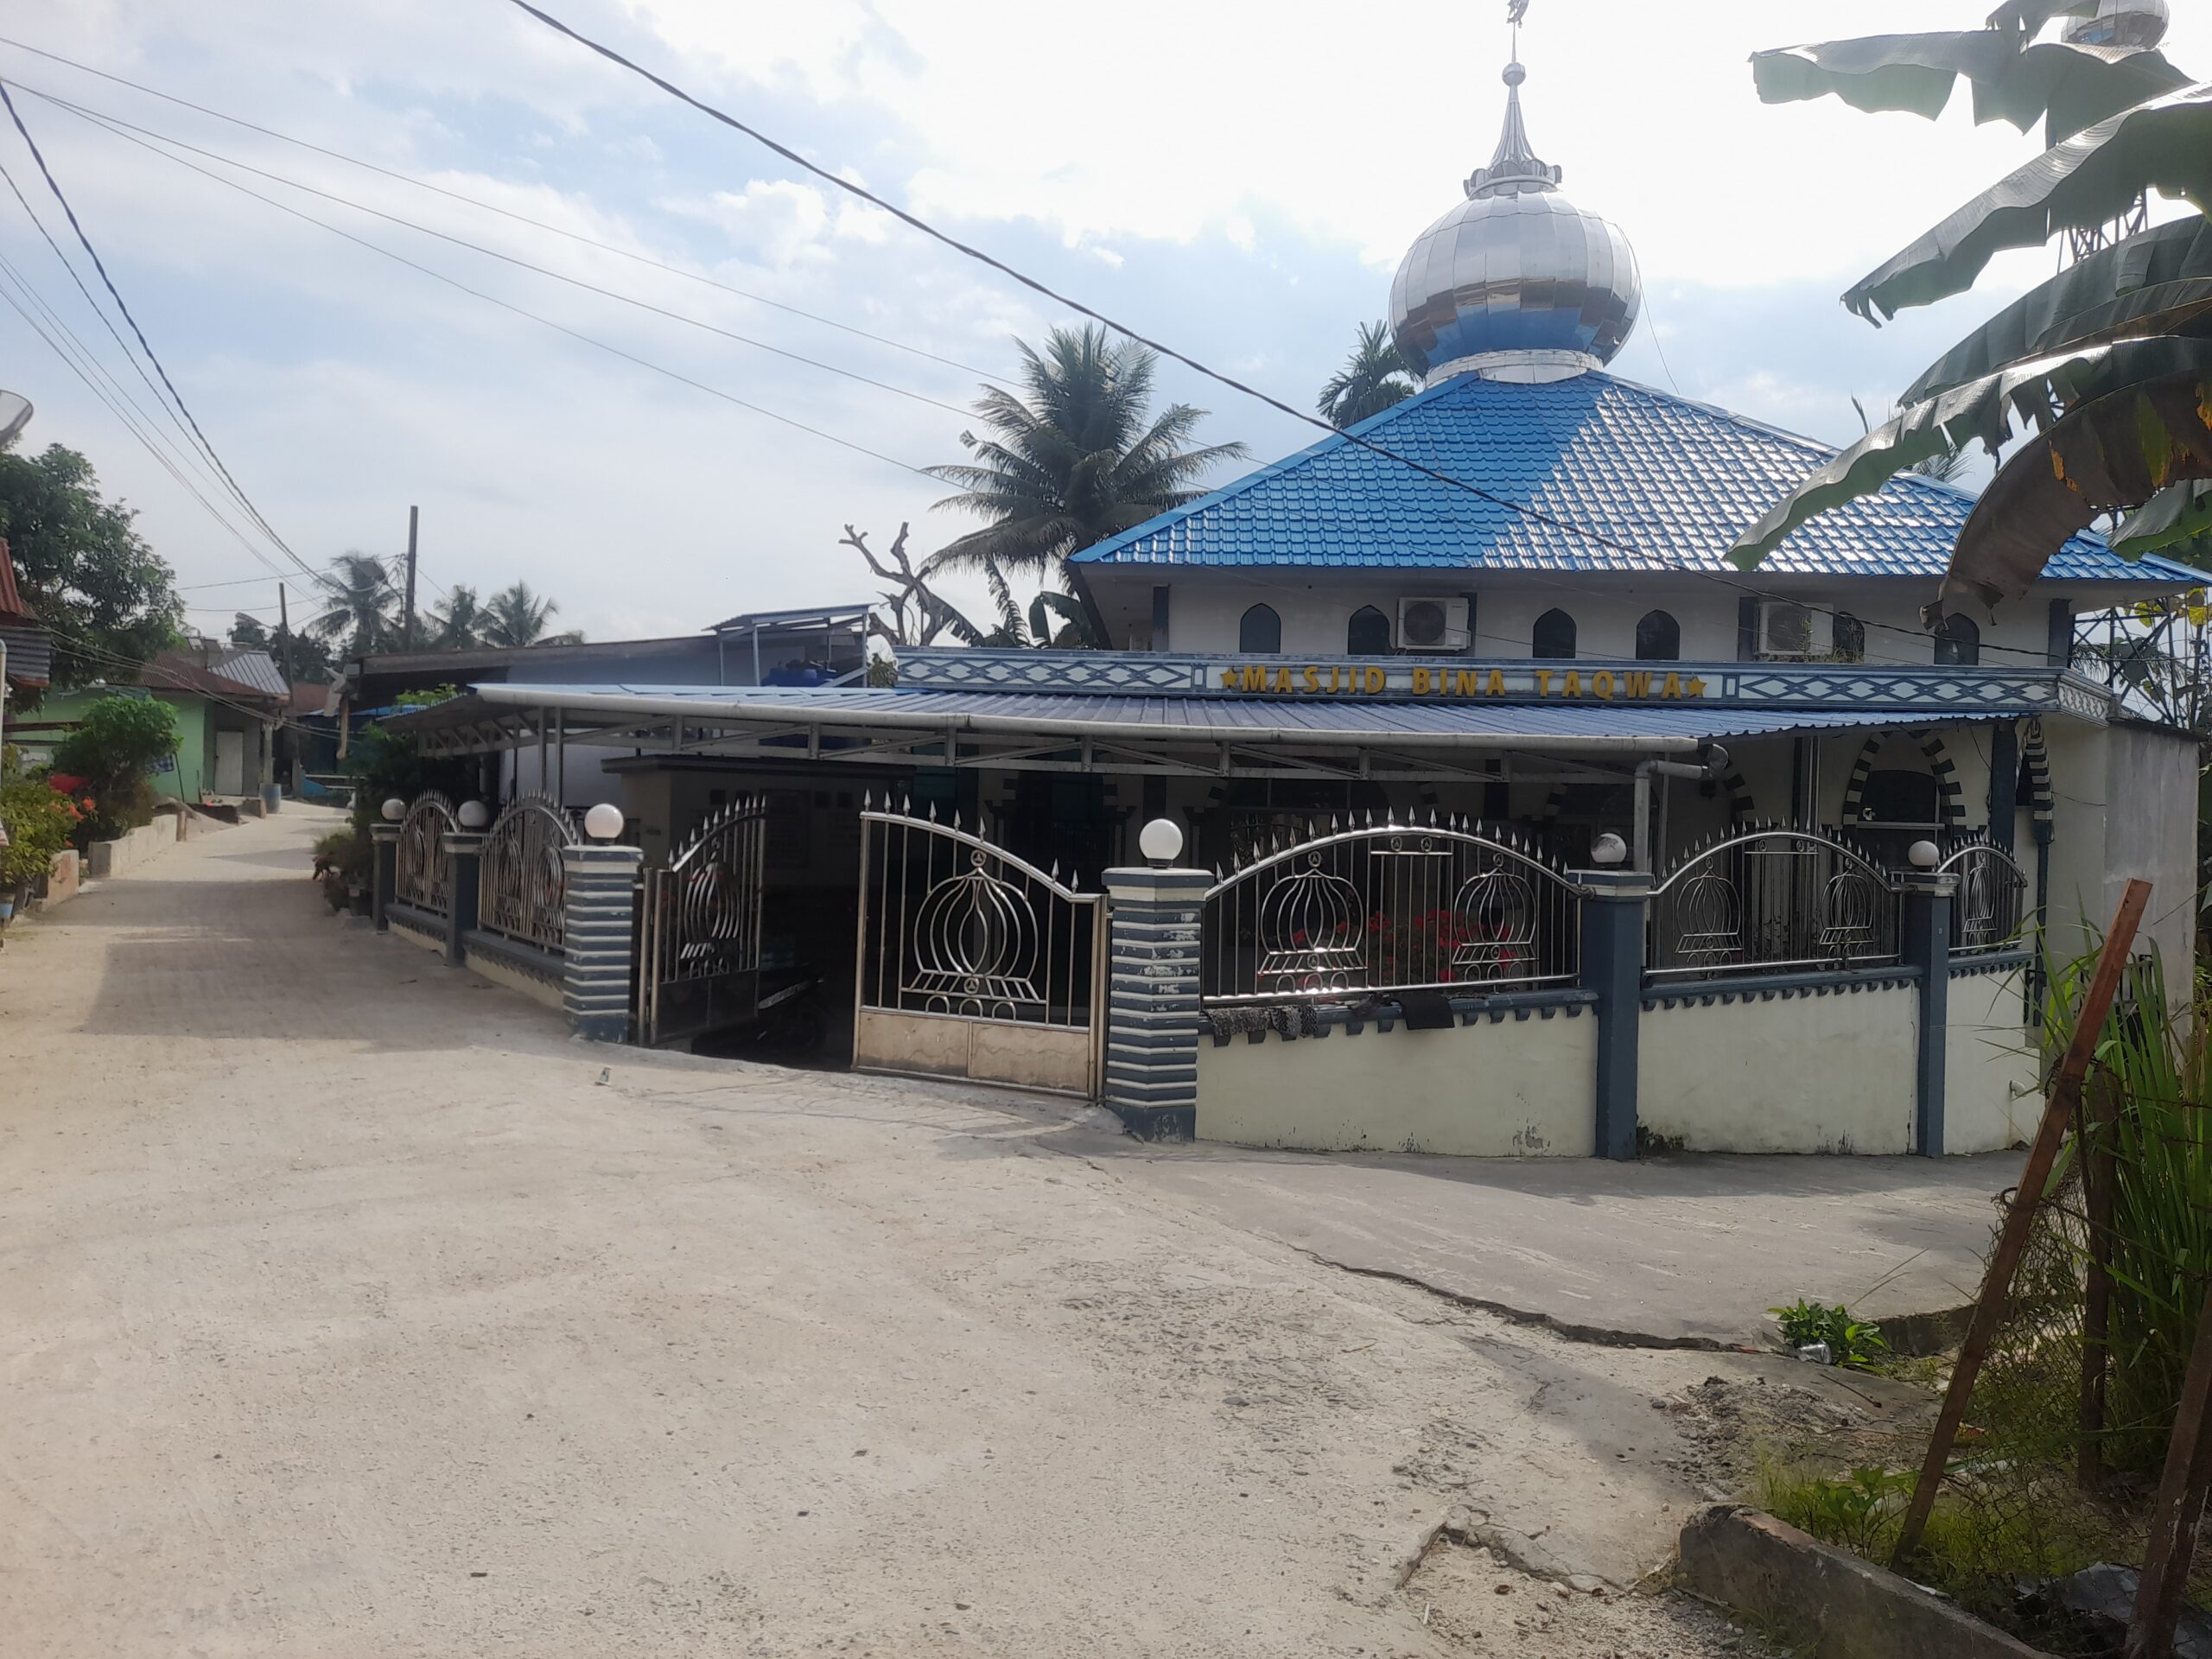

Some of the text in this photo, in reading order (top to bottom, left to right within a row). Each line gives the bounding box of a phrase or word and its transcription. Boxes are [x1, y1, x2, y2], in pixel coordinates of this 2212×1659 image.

[1242, 665, 1682, 701] MASJID BINA TAQWA
